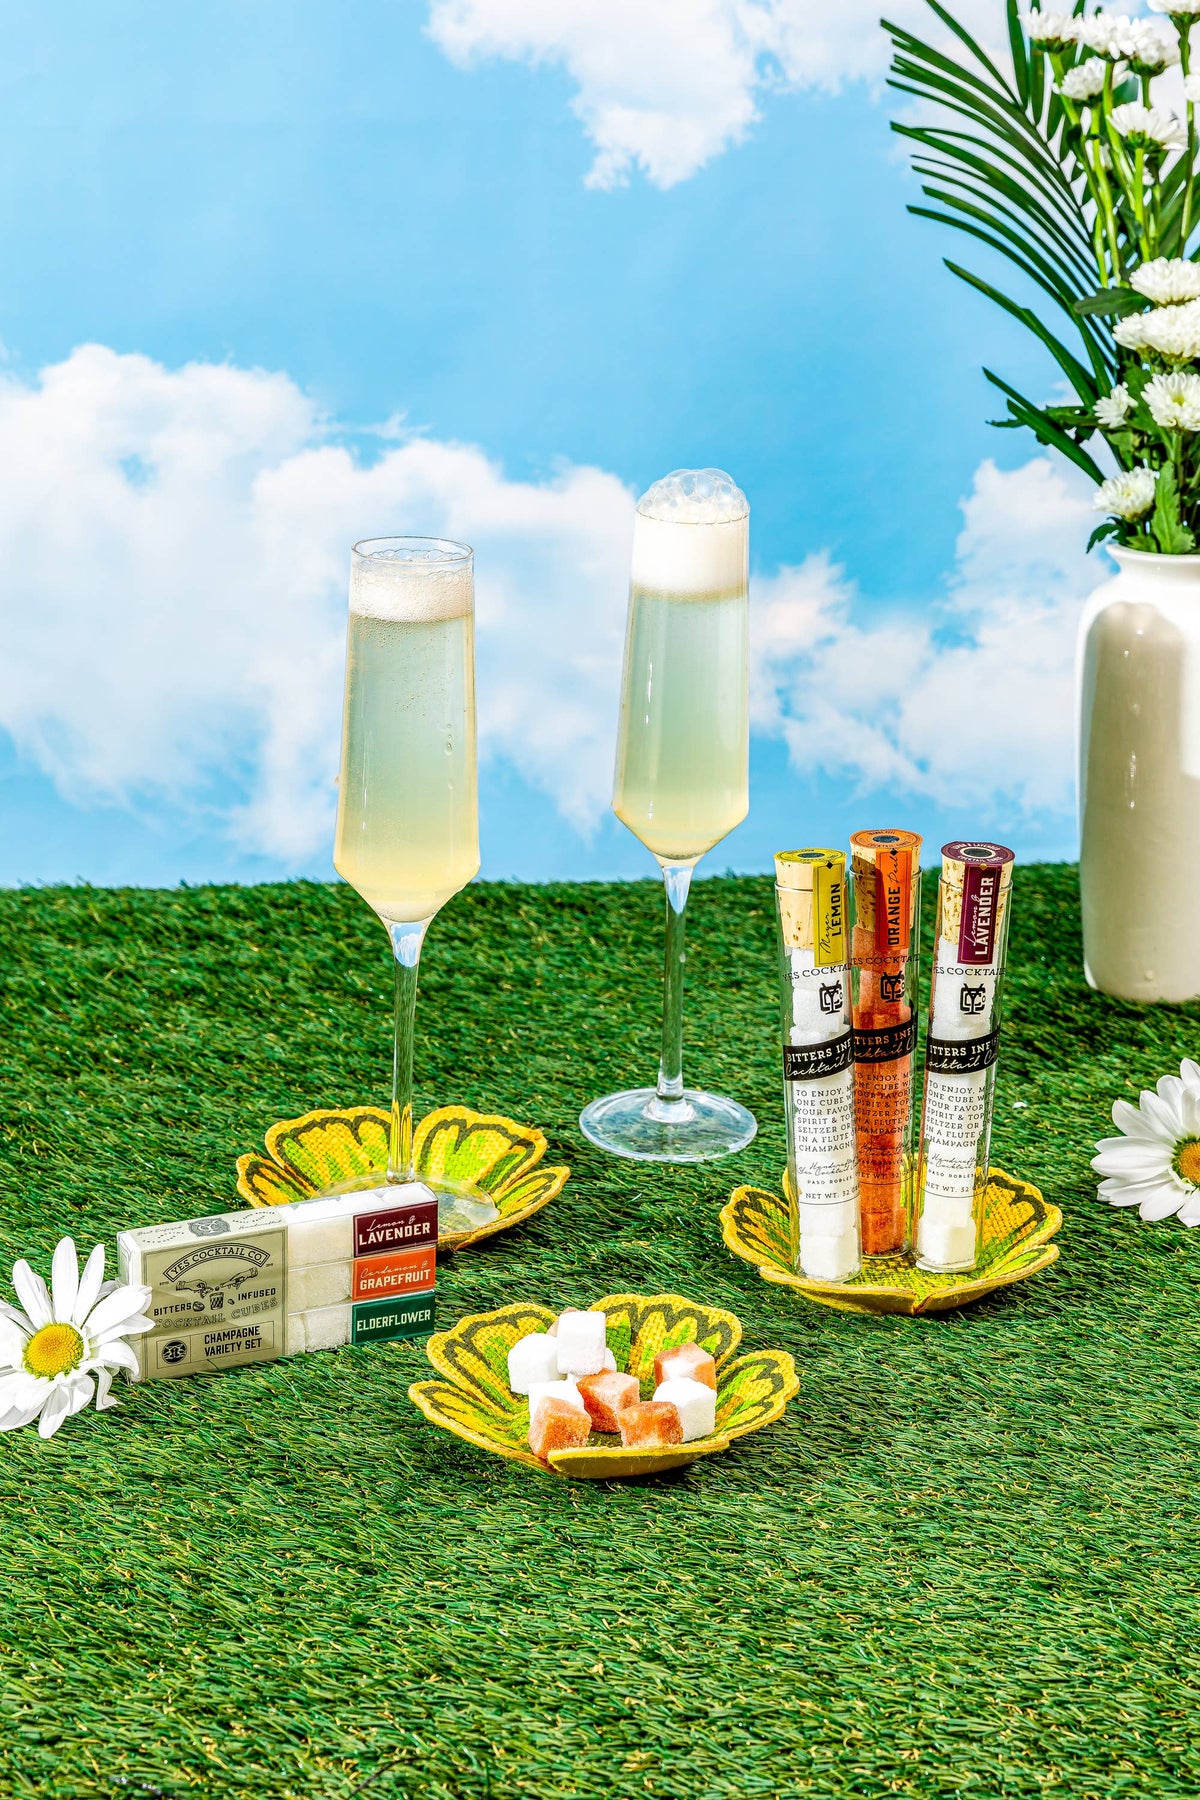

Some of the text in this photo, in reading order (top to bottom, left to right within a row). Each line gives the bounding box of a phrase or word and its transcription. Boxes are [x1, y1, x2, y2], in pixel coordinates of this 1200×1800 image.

[886, 855, 900, 946] ORANGE Peel
[830, 883, 842, 937] LEMON
[975, 877, 994, 955] LAVENDER
[820, 912, 834, 954] Meyer
[964, 906, 978, 946] Lemon
[934, 966, 944, 974] ES
[854, 1035, 890, 1046] TTERS
[786, 1048, 832, 1062] BITTERS
[930, 1041, 990, 1056] ITTERS INF
[786, 1053, 844, 1077] Cocktail
[928, 1055, 980, 1070] ocktail
[929, 1079, 938, 1088] TO
[796, 1098, 816, 1106] ONE
[820, 1096, 844, 1106] CUBE
[928, 1089, 944, 1100] ONE
[857, 1099, 880, 1108] PIRIT
[928, 1098, 984, 1112] YOUR FAVOR
[798, 1108, 823, 1116] YOUR
[857, 1108, 890, 1116] ELTZER
[927, 1106, 954, 1120] SPIRIT
[798, 1116, 828, 1124] SPIRIT
[832, 1116, 838, 1124] &
[874, 1118, 902, 1126] FLUTE
[926, 1116, 963, 1130] SELTZER
[967, 1122, 980, 1130] OR
[798, 1122, 850, 1134] SELTZER OR
[822, 1132, 848, 1143] FLUTE
[806, 1192, 822, 1200] NET
[366, 1218, 405, 1232] Lemon
[359, 1222, 430, 1246] LAVENDER
[170, 1246, 262, 1275] YES COCKTAIL CO.
[360, 1266, 418, 1279] Cardamom
[360, 1268, 432, 1291] GRAPEFRUIT
[154, 1288, 276, 1316] BITTERS INFUSED
[154, 1297, 278, 1328] COCKTAIL CUBES
[356, 1310, 431, 1332] ELDERFLOWER
[204, 1326, 260, 1344] CHAMPAGNE
[204, 1338, 262, 1356] VARIETY SET
